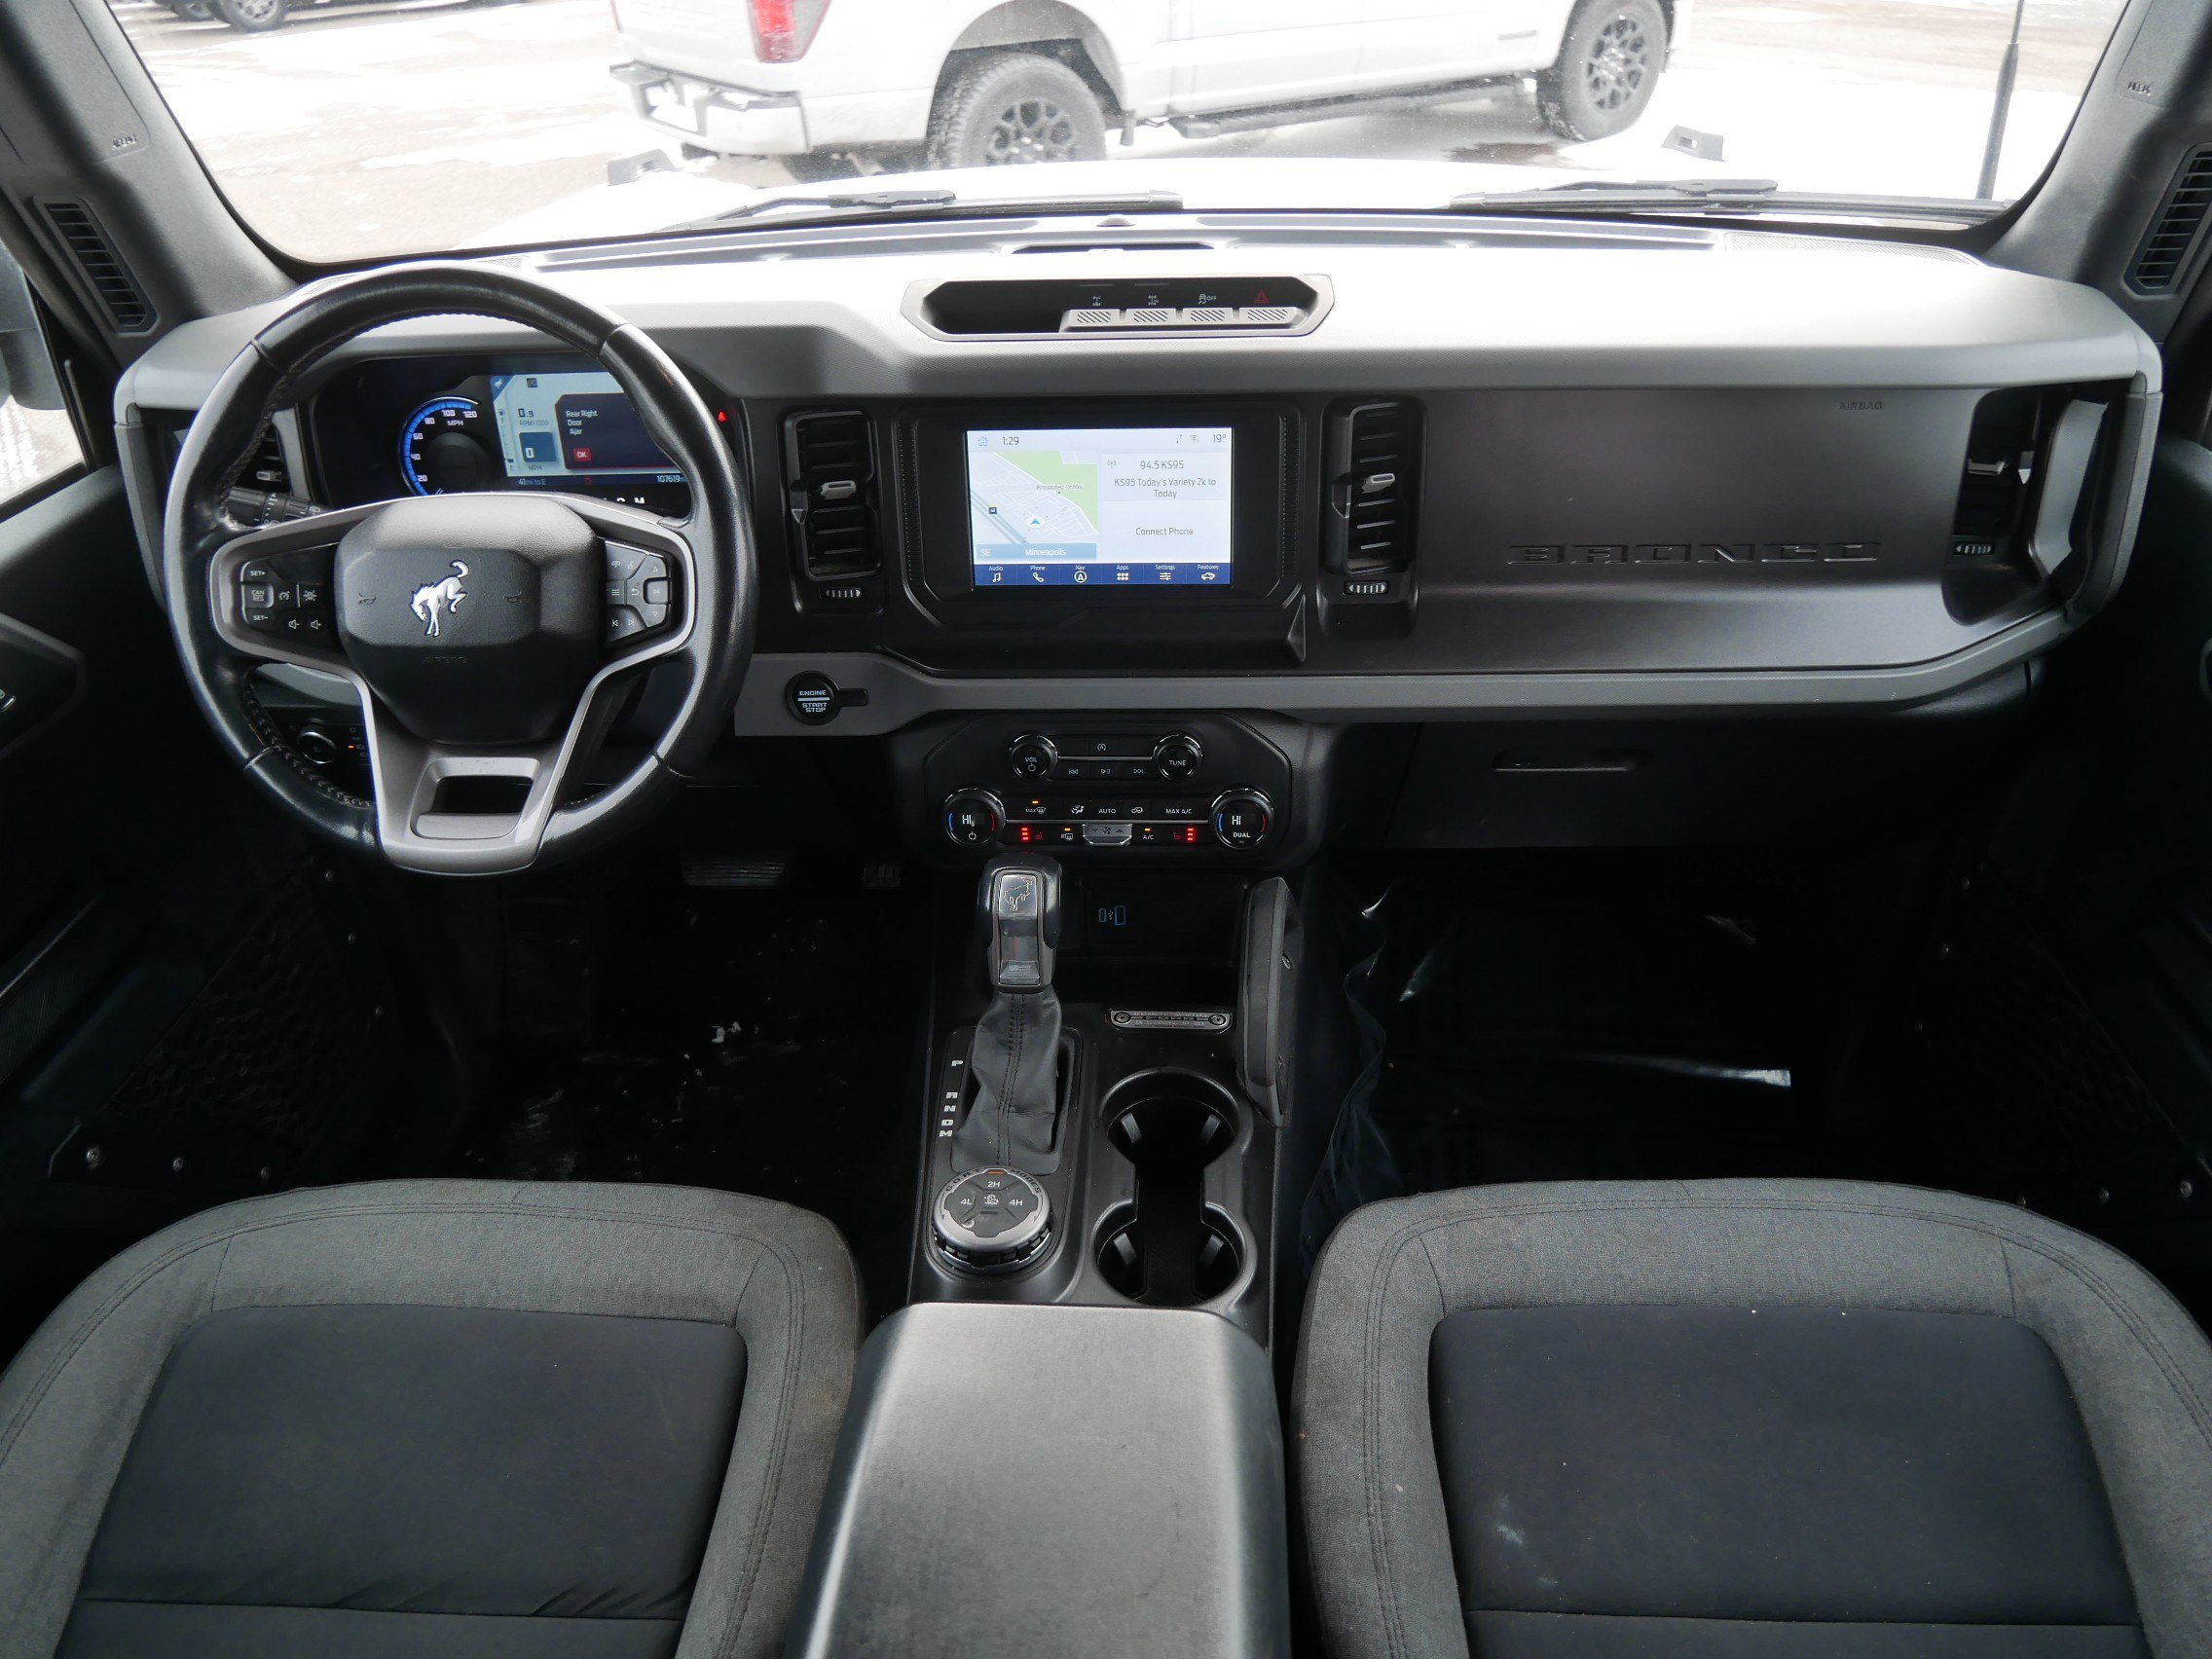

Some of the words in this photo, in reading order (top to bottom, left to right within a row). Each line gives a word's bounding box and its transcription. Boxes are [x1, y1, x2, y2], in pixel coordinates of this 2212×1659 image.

[1837, 401, 1883, 410] AIRBAG
[580, 410, 598, 419] Right
[1002, 436, 1019, 446] 1:29
[1139, 460, 1160, 469] 94.5
[1161, 460, 1185, 469] KS95
[1114, 477, 1136, 487] KS95
[1137, 477, 1167, 487] Today's
[1167, 477, 1196, 487] Variety
[1197, 477, 1206, 486] 2k
[1207, 477, 1217, 486] to
[1153, 489, 1177, 498] Today
[1135, 527, 1167, 535] Connect
[1168, 527, 1194, 535] Phone
[980, 548, 991, 557] SE
[1025, 547, 1067, 556] Minneapolis
[1507, 541, 1881, 566] BRONCO
[962, 814, 972, 826] HI
[1232, 815, 1241, 827] HI
[1010, 1168, 1042, 1194] MODES
